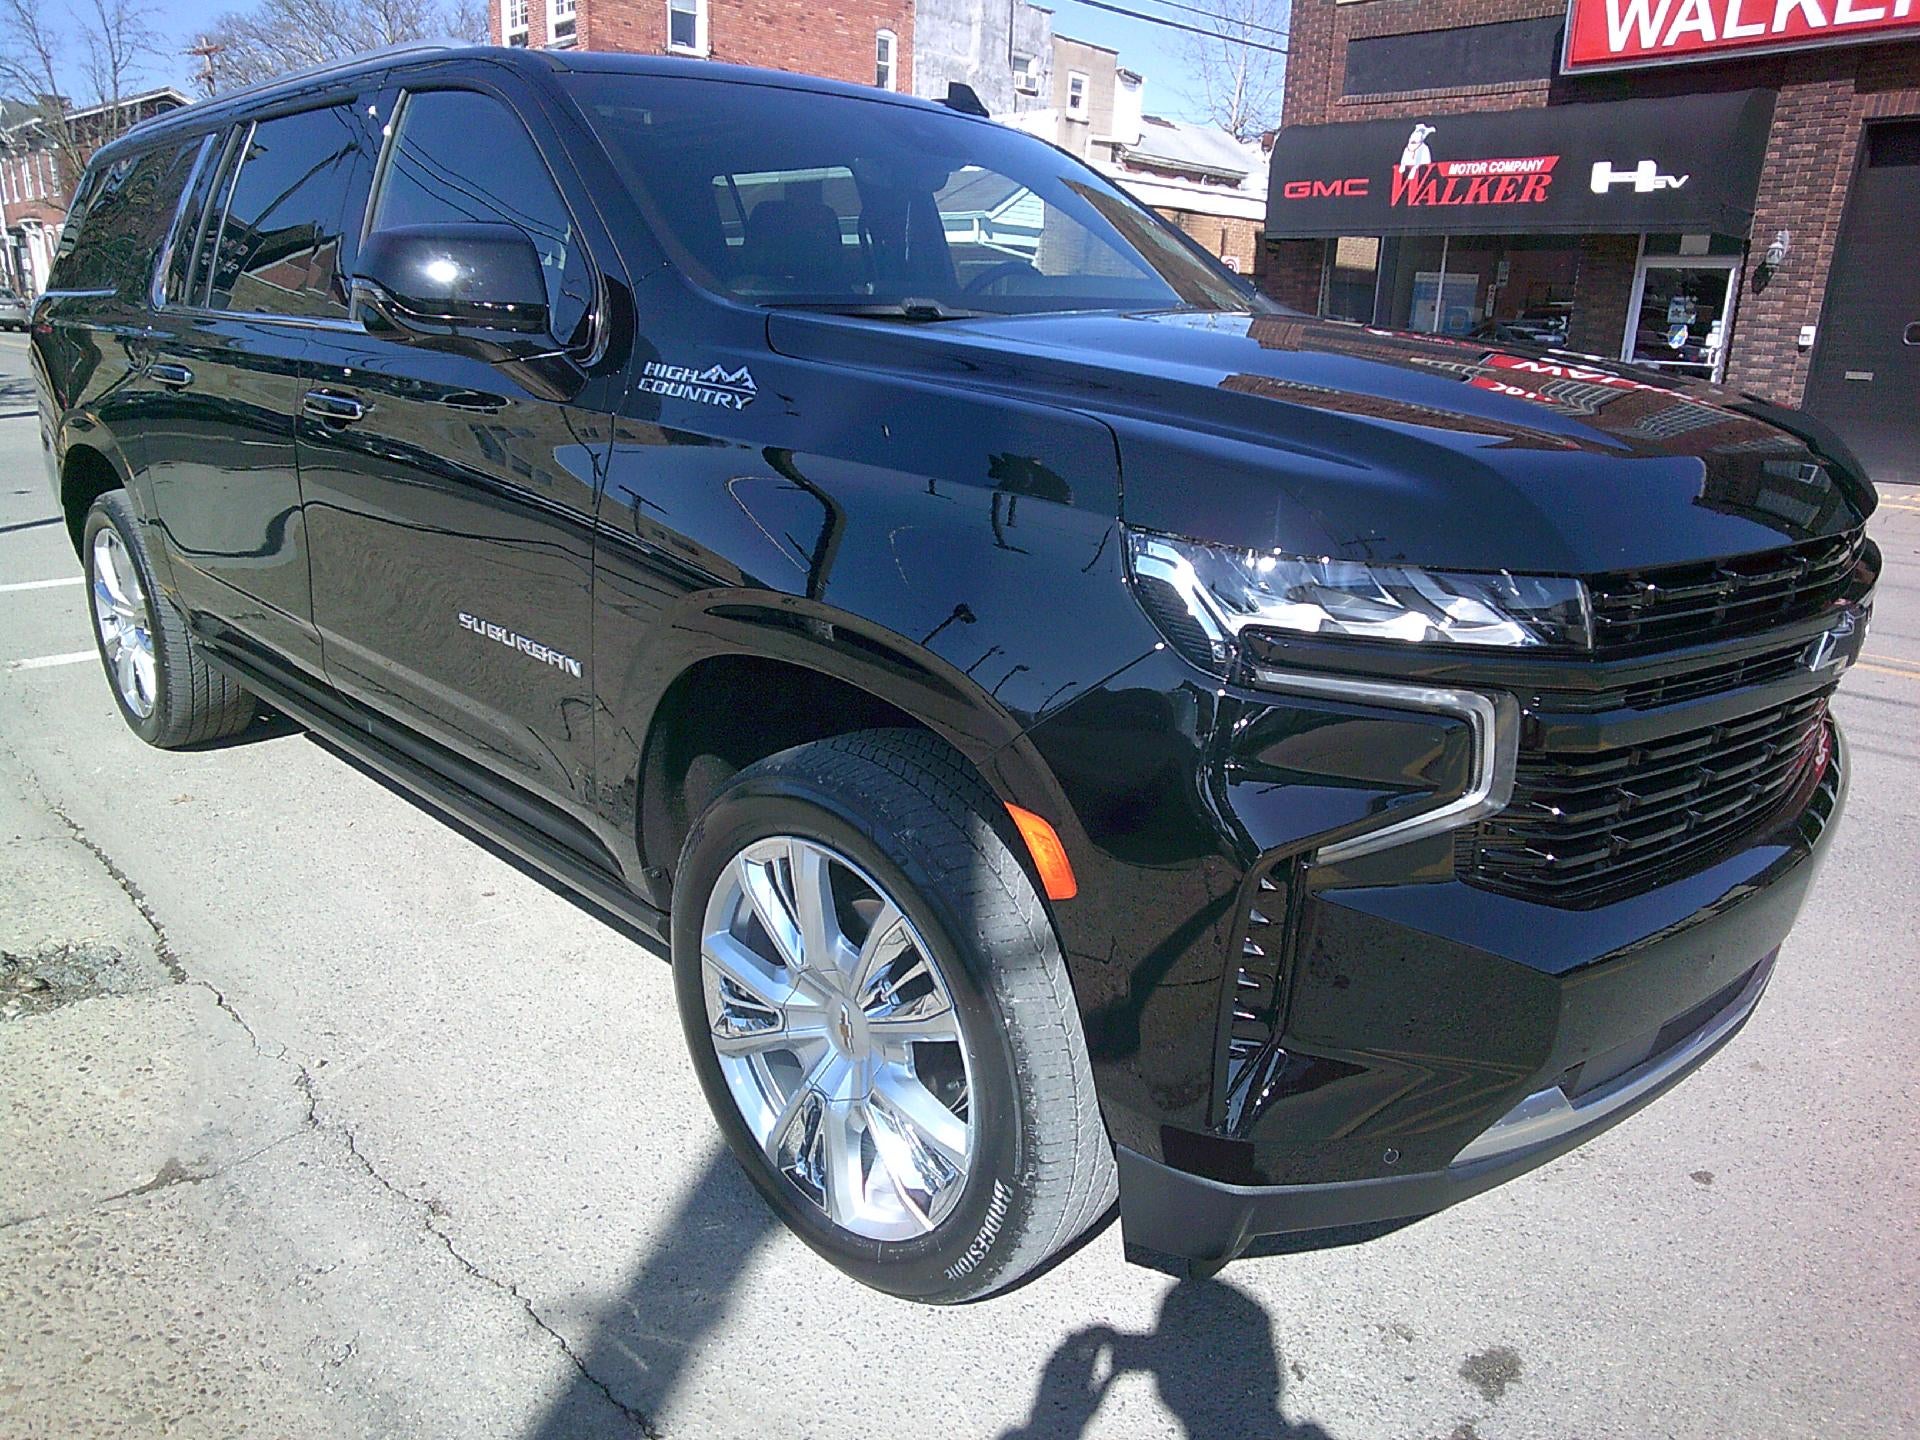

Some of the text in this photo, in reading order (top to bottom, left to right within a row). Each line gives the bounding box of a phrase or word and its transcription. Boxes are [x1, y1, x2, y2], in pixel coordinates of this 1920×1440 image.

[1449, 158, 1545, 175] MOTOR COMPANY
[1284, 178, 1370, 199] GMC
[1390, 163, 1553, 207] WALKER
[643, 361, 701, 383] HIGH
[638, 377, 755, 410] COUNTRY
[458, 611, 584, 679] SUBURBAN
[943, 1178, 1014, 1281] BRIDGESTONE
